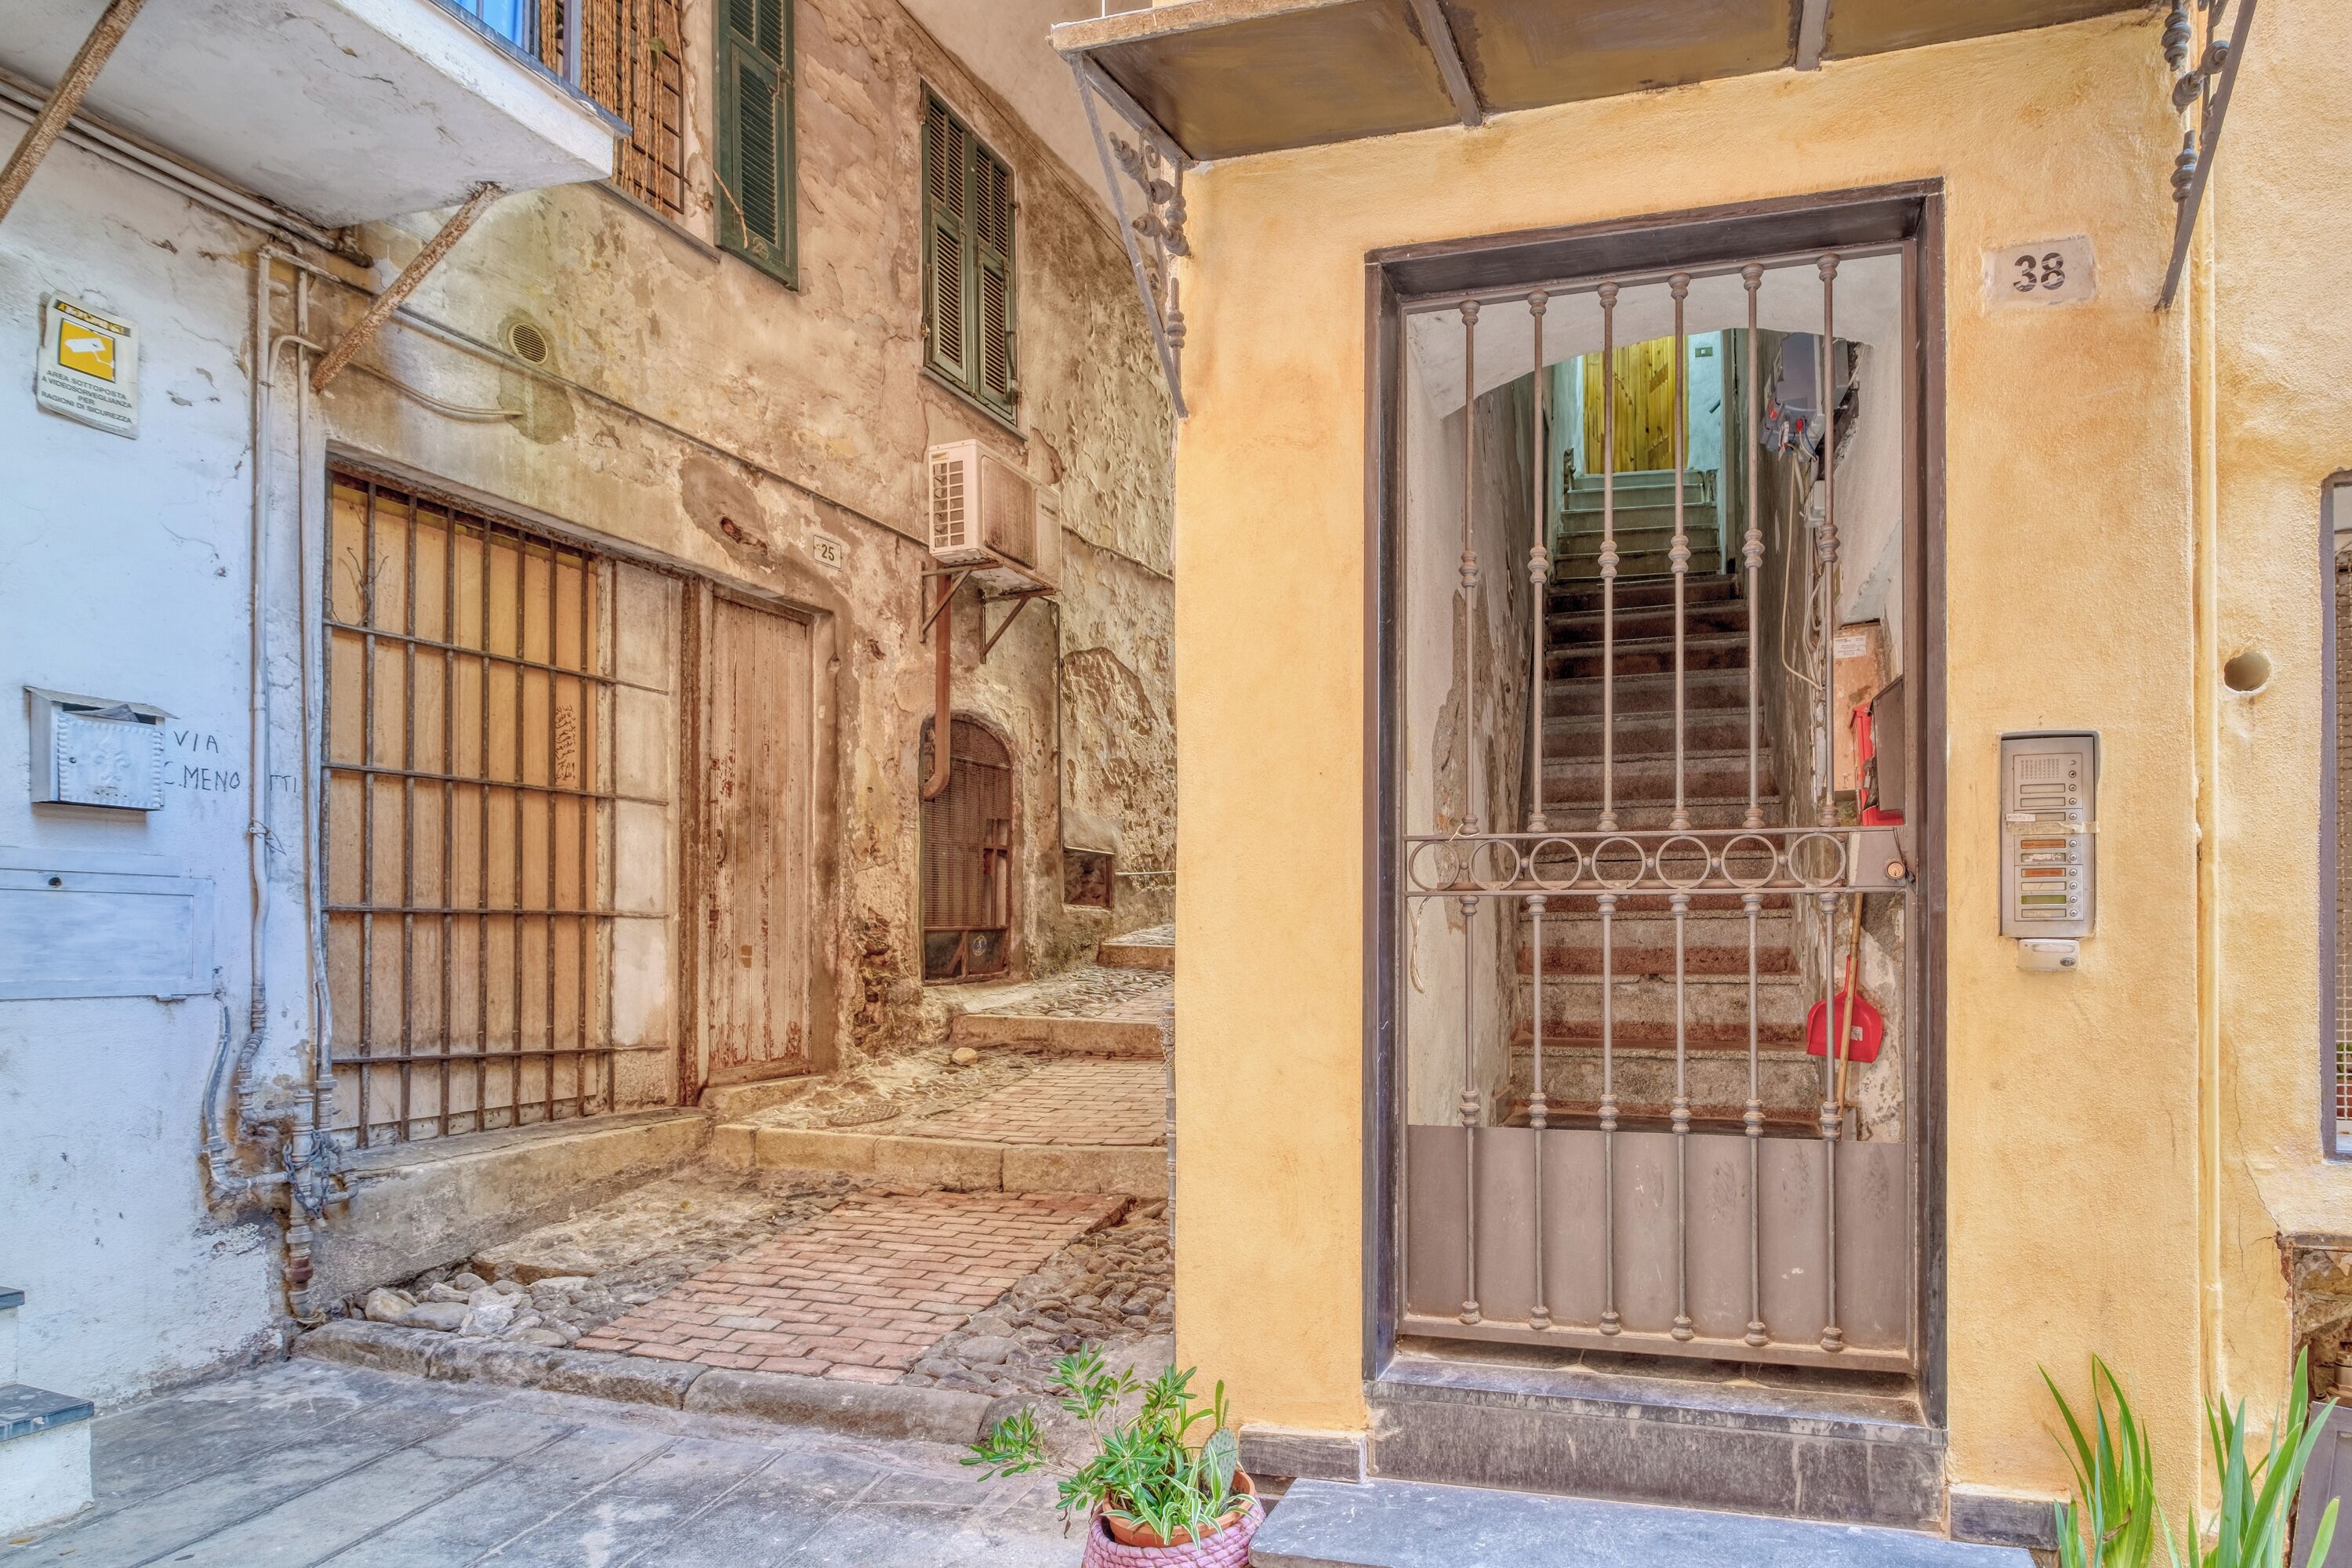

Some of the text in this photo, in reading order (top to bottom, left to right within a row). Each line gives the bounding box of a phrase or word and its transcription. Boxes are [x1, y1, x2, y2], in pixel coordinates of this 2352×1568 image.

[2013, 252, 2065, 292] 38
[47, 370, 127, 400] AREA SOTTOPOSTA
[49, 377, 132, 408] VIDEOSORVEGLIANZA
[78, 395, 95, 405] PER
[42, 390, 74, 407] RAGIONI
[86, 405, 132, 423] SICUREZZA
[821, 543, 835, 561] 25
[173, 730, 219, 753] VIA
